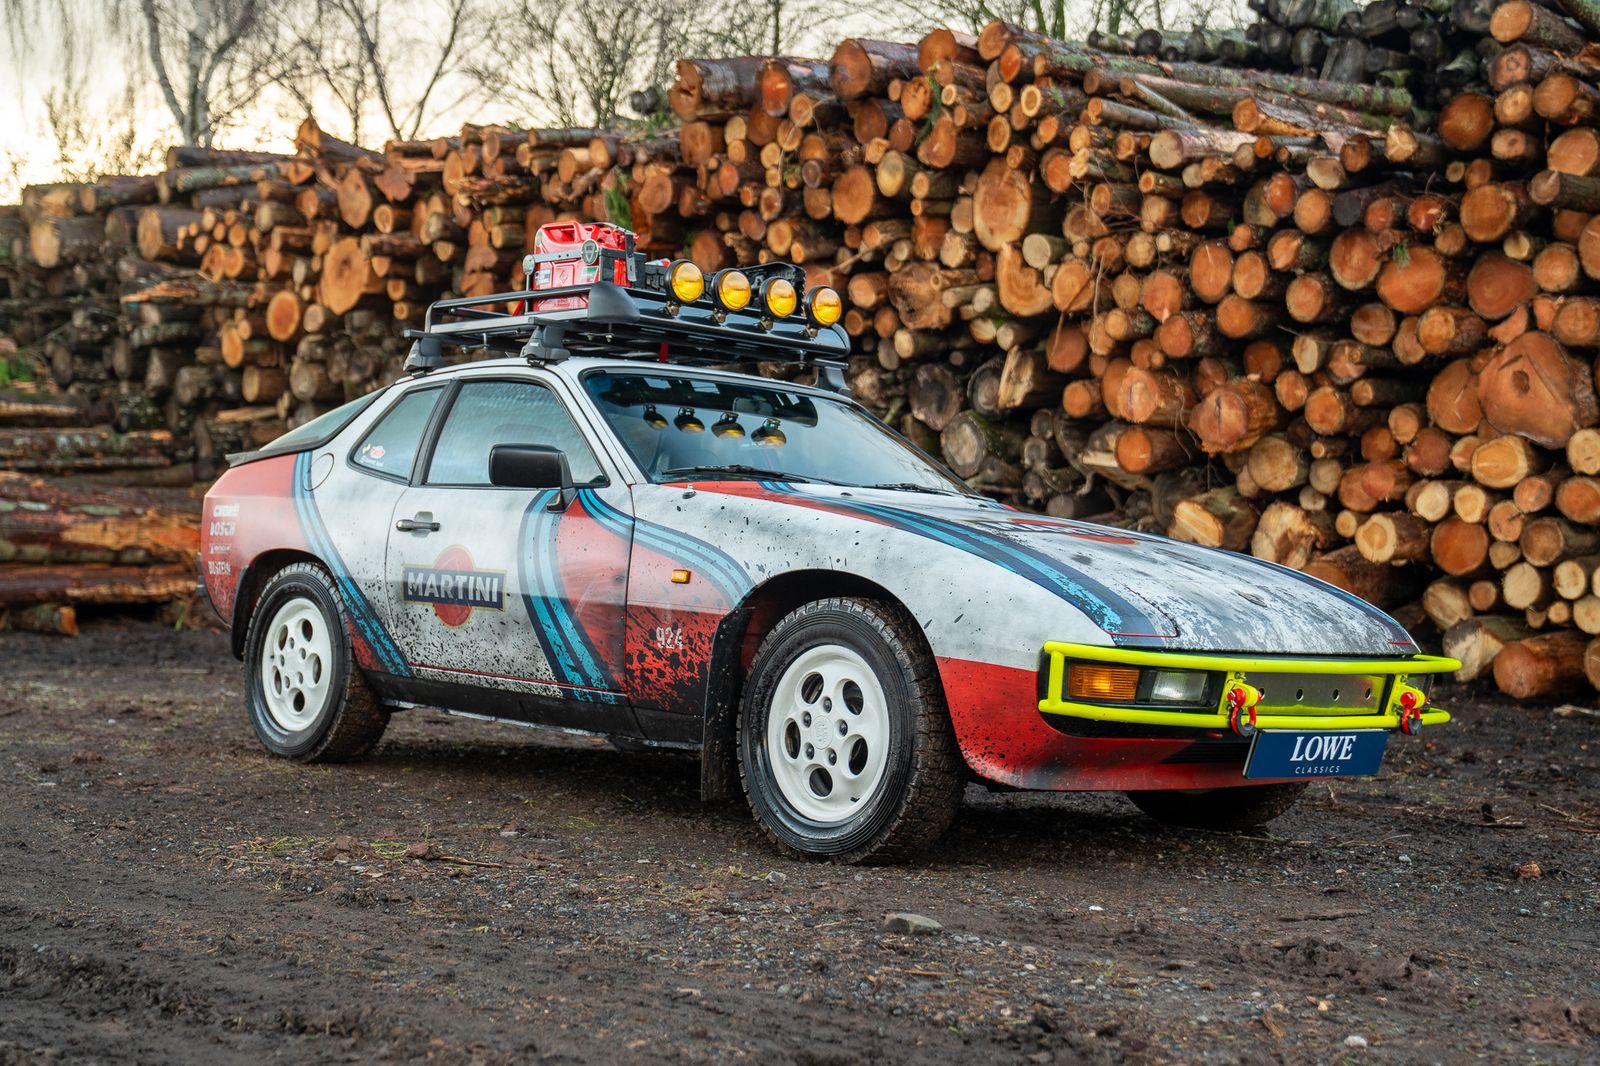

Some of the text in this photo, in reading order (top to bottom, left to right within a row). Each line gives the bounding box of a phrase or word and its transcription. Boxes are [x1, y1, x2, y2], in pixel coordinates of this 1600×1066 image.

[407, 571, 499, 603] MARTINI
[656, 626, 683, 650] 924
[1290, 735, 1357, 762] LOWE
[1295, 765, 1341, 774] CLASSICS
